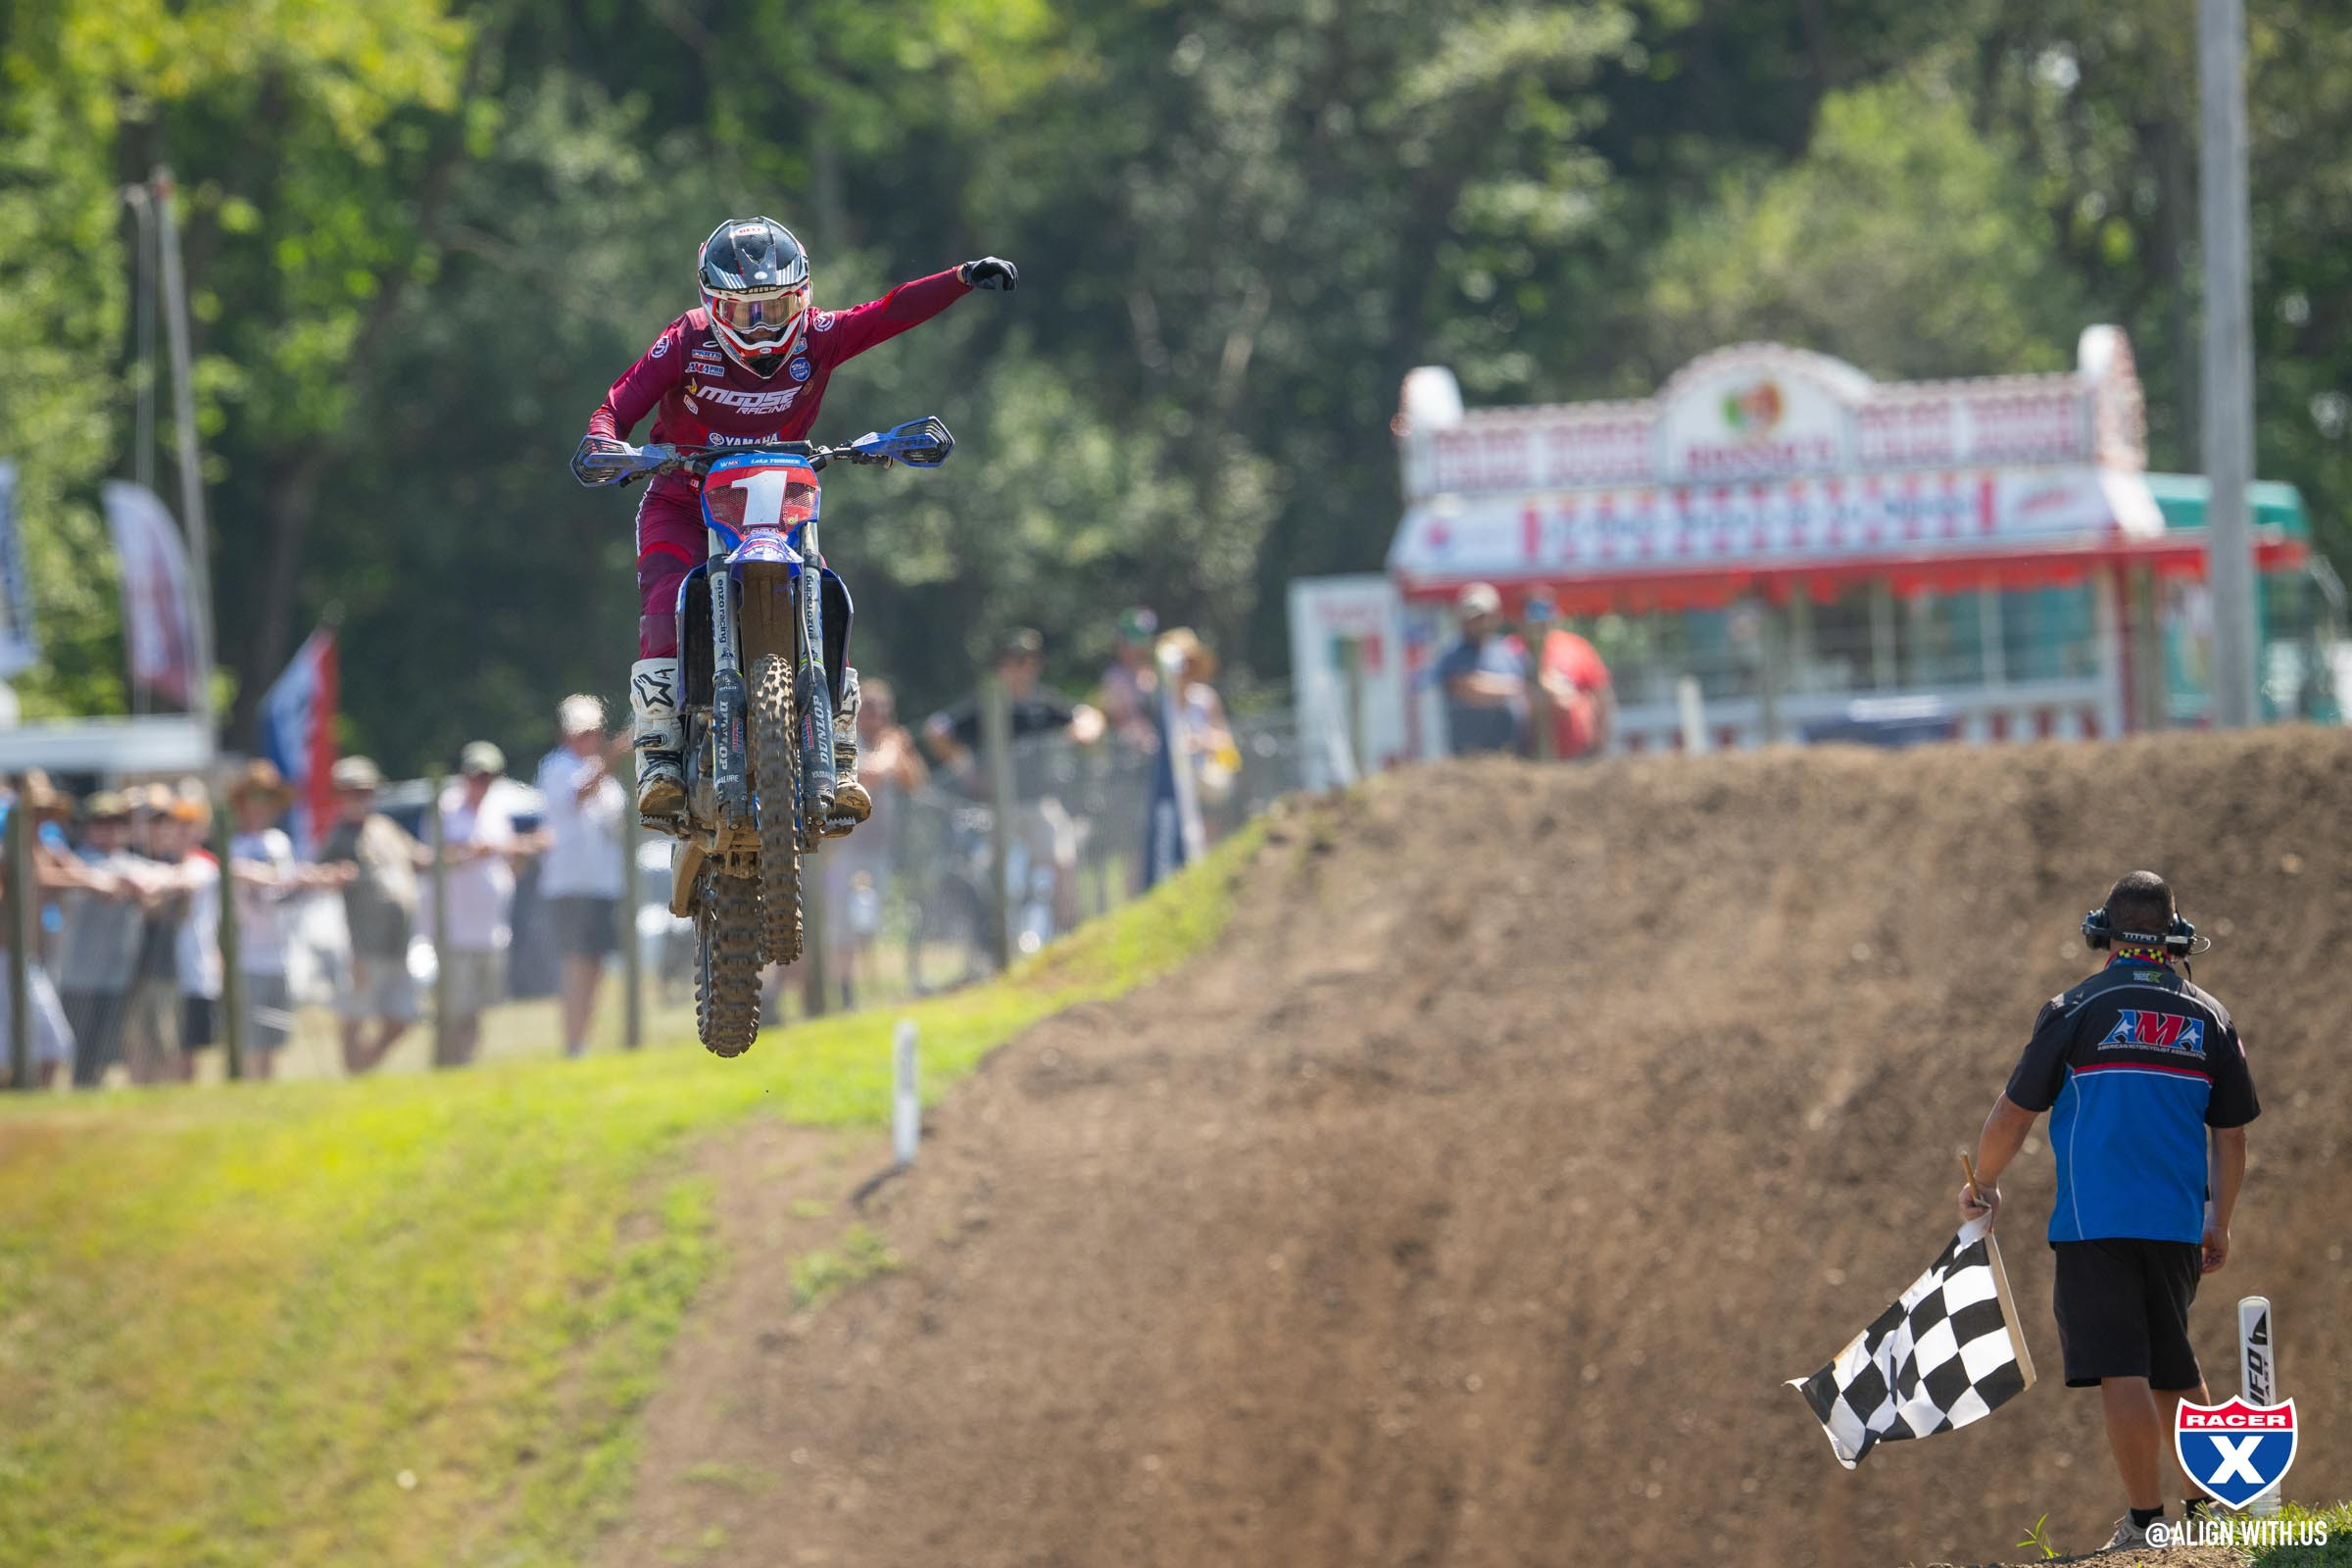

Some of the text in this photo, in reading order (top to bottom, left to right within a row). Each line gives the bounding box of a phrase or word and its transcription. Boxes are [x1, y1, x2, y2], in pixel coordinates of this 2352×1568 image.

[685, 362, 710, 374] AMA
[697, 385, 804, 408] MOOSE
[736, 399, 792, 415] RACING
[725, 433, 778, 447] YAMAHA
[731, 469, 788, 526] 1
[805, 575, 814, 610] racing
[716, 578, 728, 644] enzo racing
[812, 695, 830, 766] DUNLOP
[2123, 932, 2157, 941] TITAN
[2100, 1008, 2206, 1053] AMA
